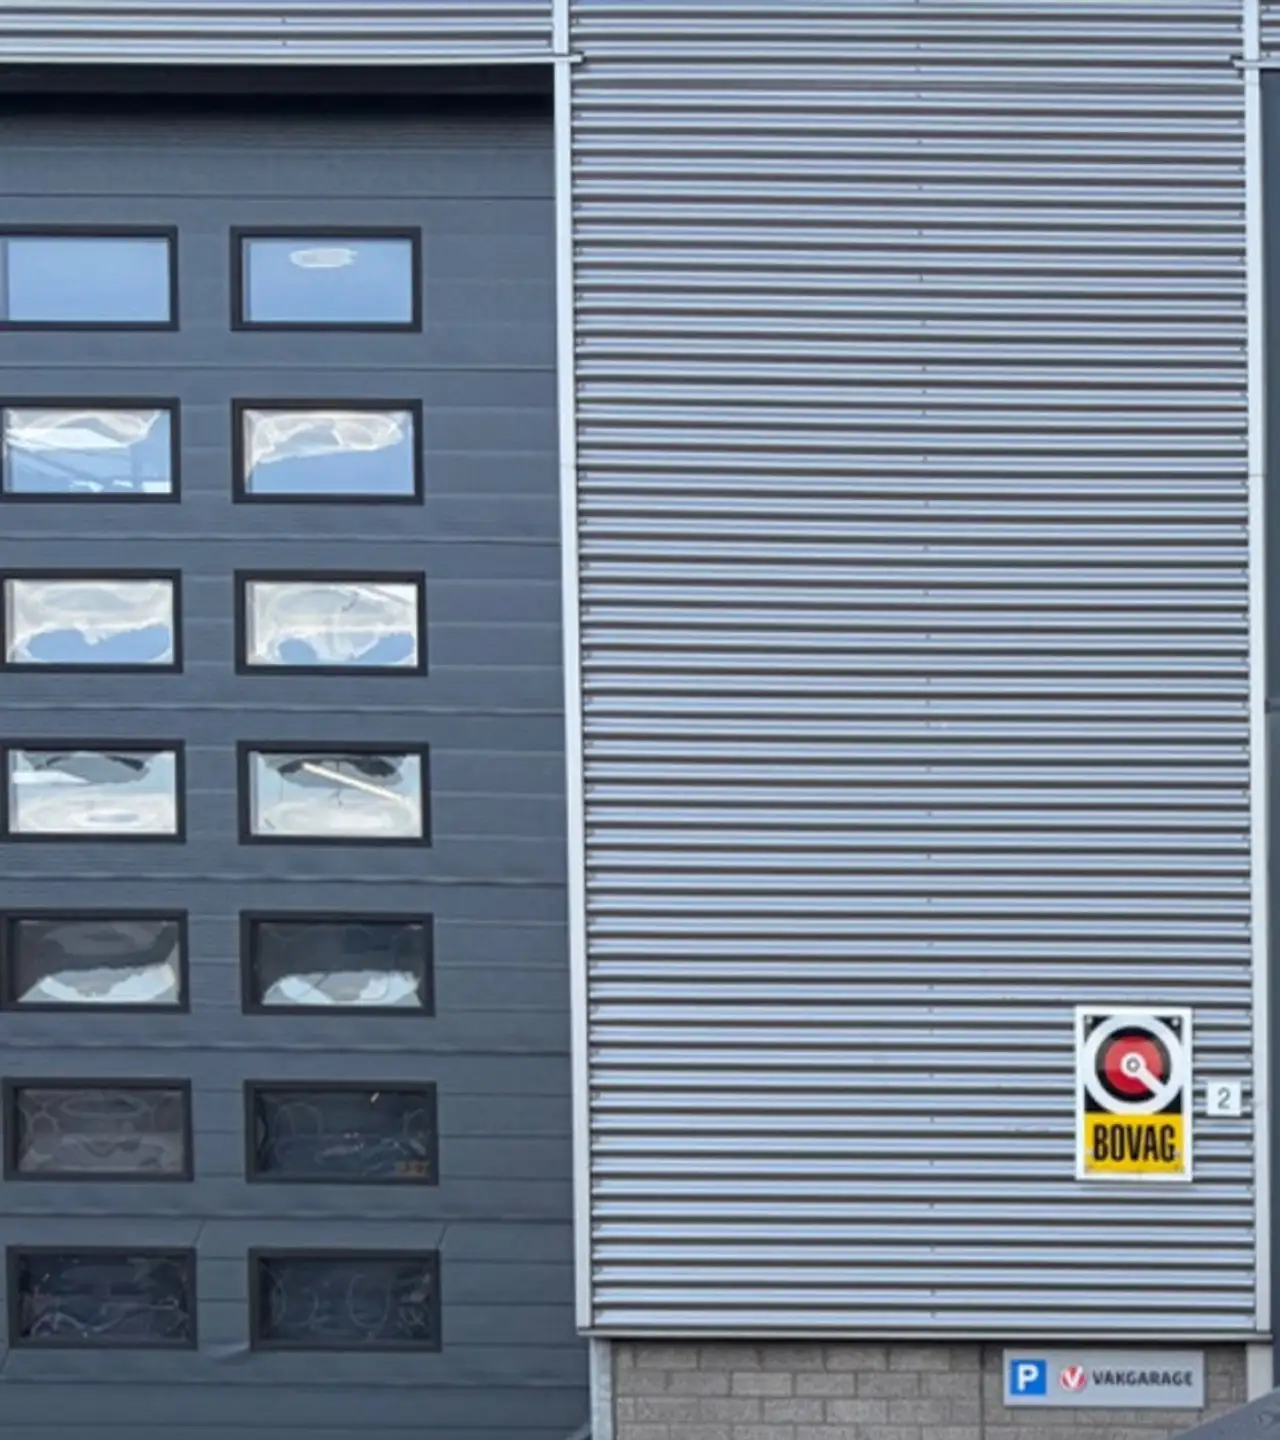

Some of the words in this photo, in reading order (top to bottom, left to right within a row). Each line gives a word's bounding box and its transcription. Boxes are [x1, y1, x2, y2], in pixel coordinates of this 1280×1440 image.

[1216, 1086, 1231, 1110] 2
[1092, 1123, 1176, 1163] BOVAG
[1092, 1368, 1194, 1387] VAKGARAGE
